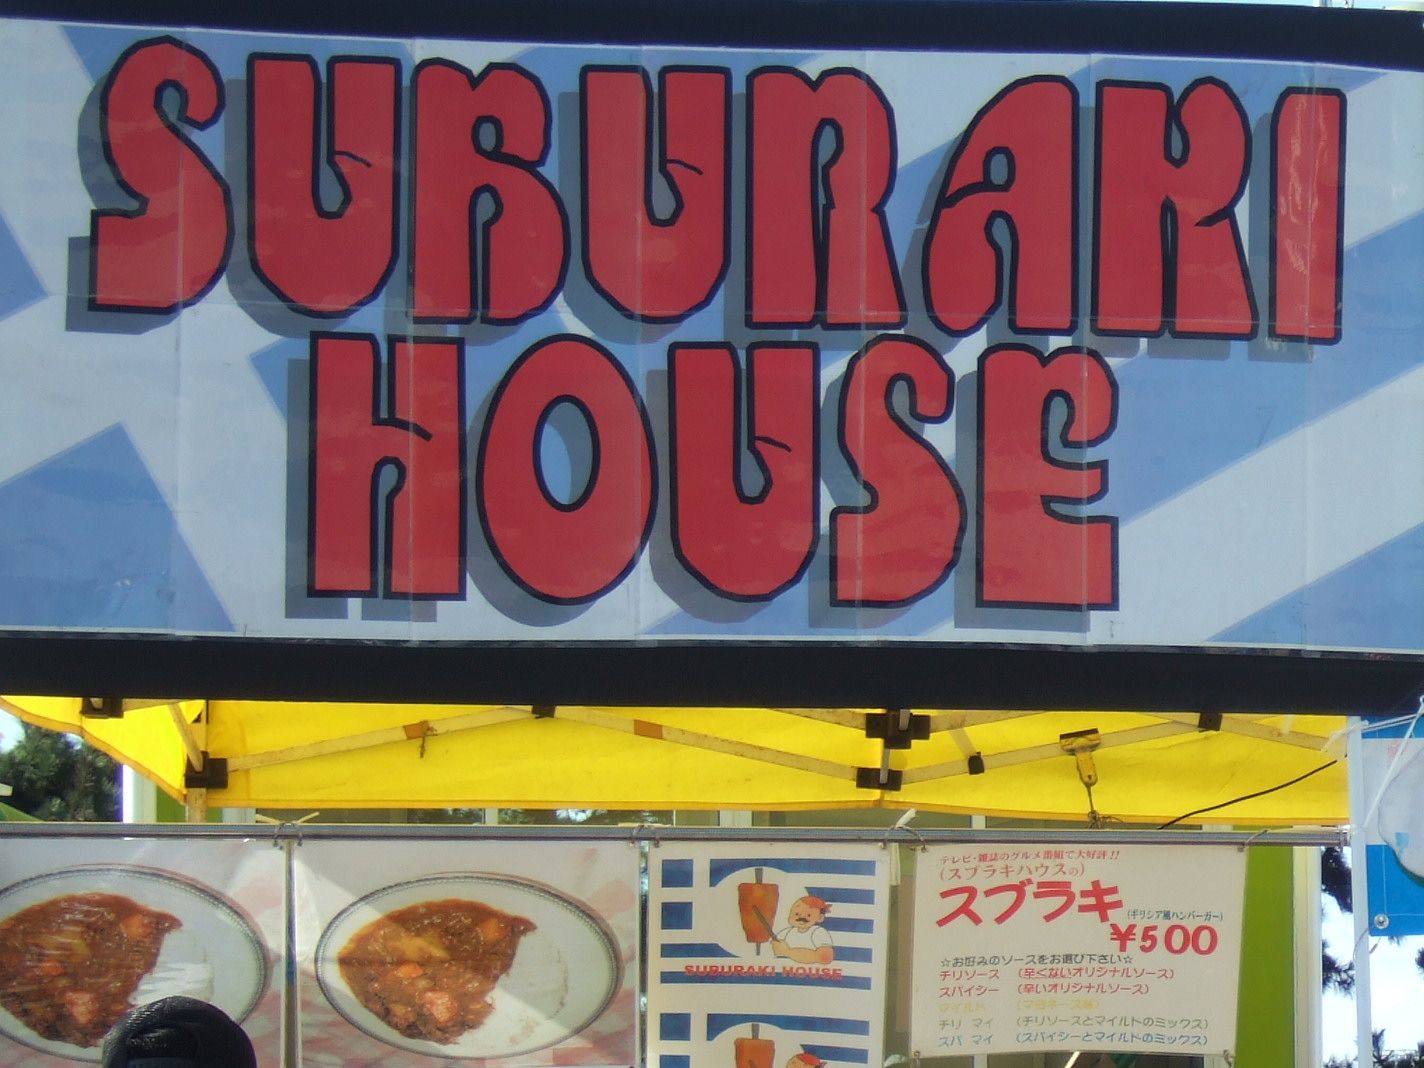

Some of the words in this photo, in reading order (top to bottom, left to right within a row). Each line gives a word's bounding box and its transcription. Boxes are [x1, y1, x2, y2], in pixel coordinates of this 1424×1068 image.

[88, 36, 1347, 345] SUBURAKI
[308, 331, 1119, 610] HOUSE
[936, 878, 1124, 928] スブラキ
[1110, 922, 1219, 956] ¥500
[939, 969, 1001, 981] チリソース
